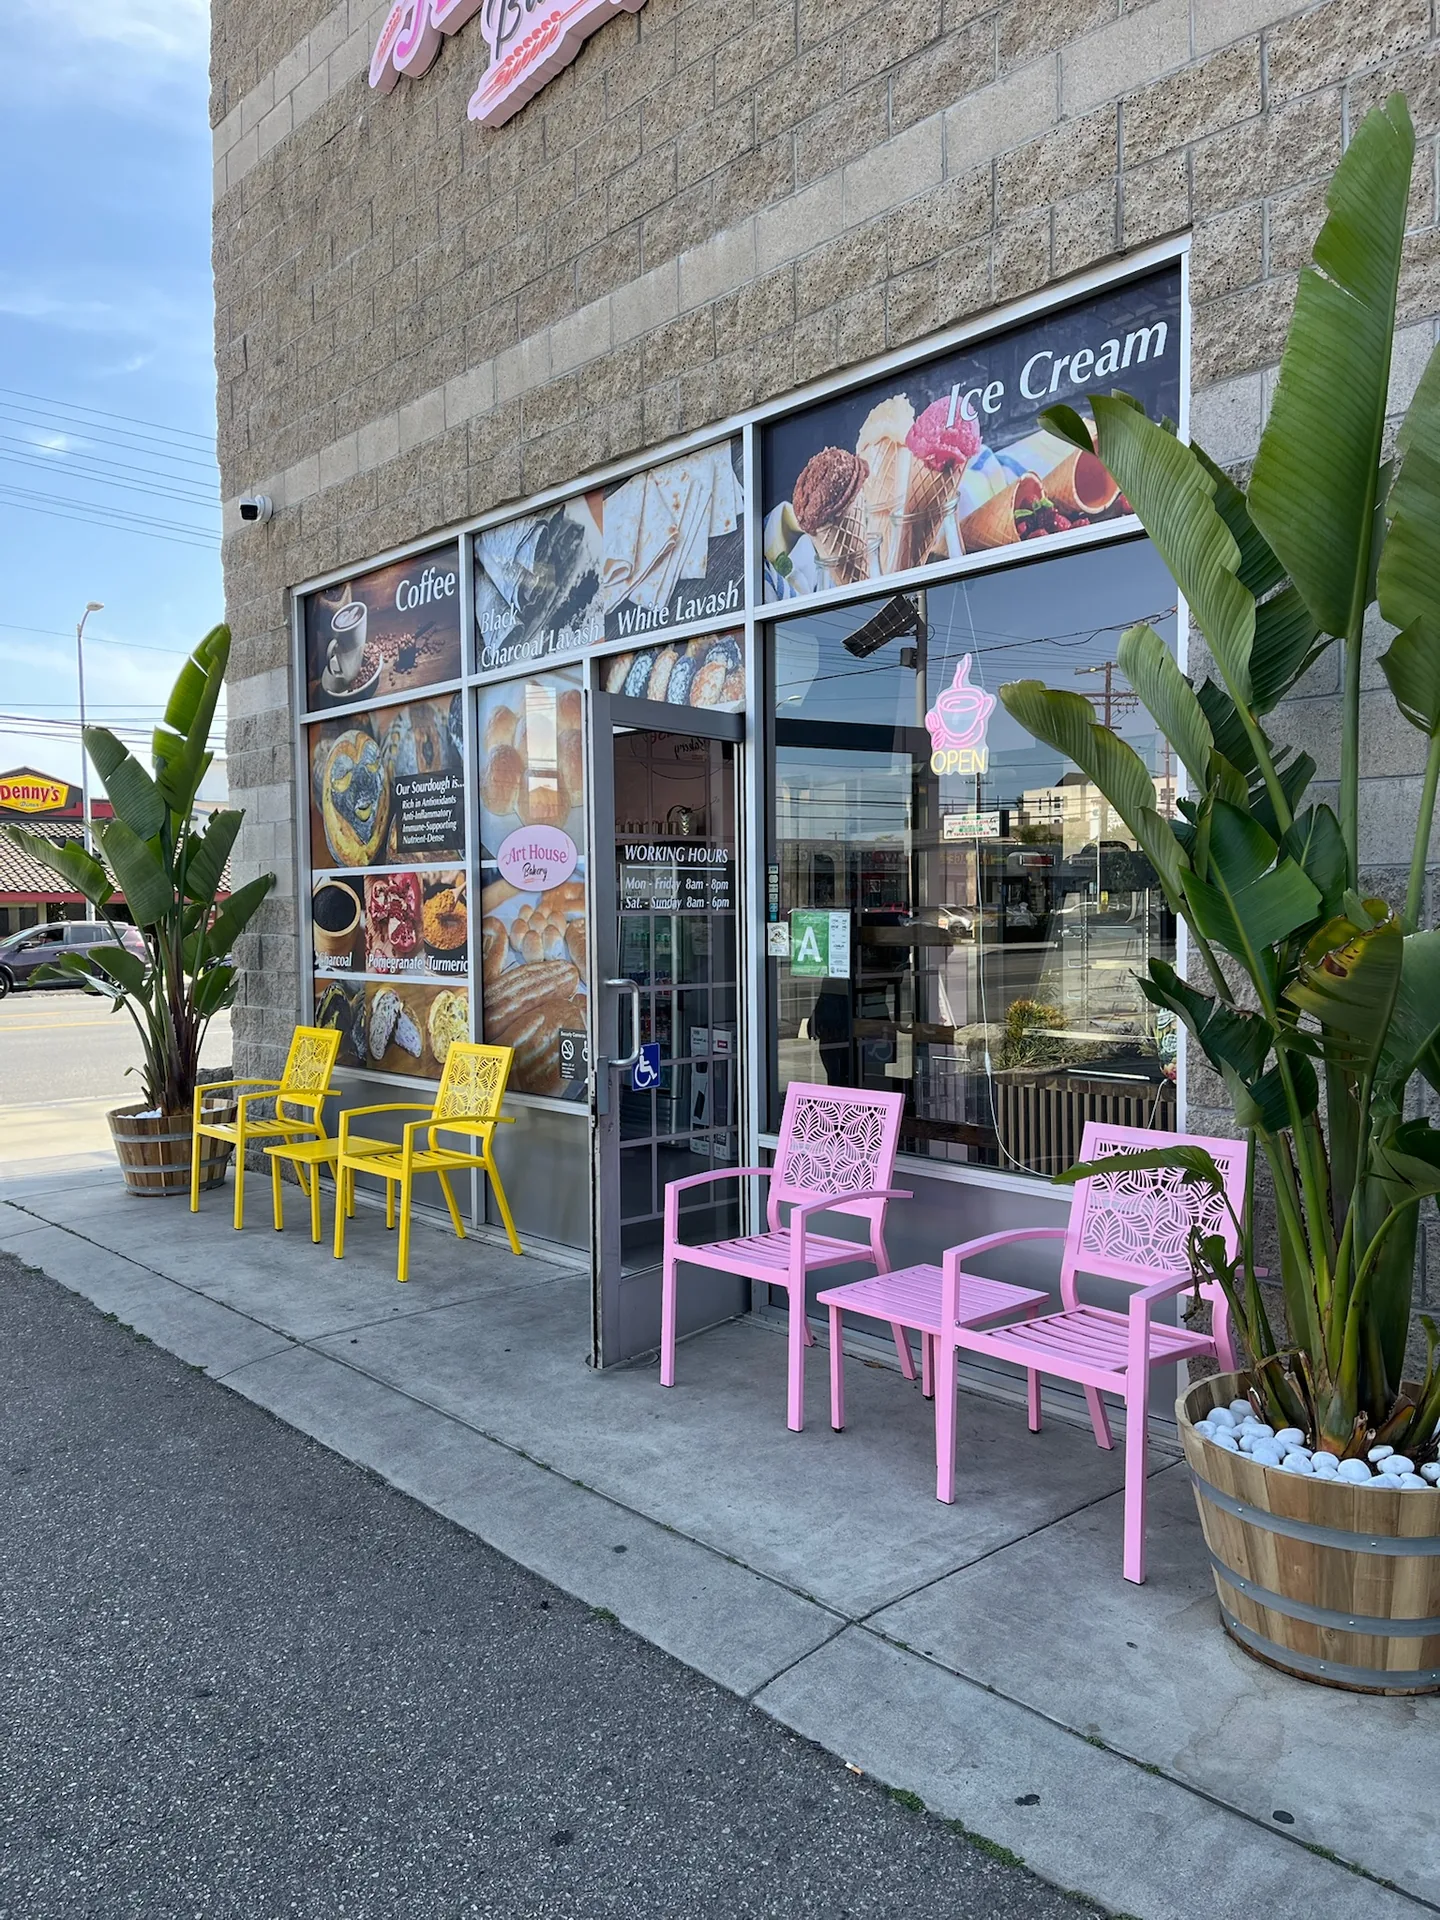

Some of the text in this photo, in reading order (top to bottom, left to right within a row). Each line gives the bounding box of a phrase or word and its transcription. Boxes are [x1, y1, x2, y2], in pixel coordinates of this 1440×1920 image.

[946, 321, 1168, 428] Ice Cream
[395, 566, 456, 612] Coffee
[617, 579, 739, 636] White Lavash
[480, 603, 518, 634] Black
[481, 623, 599, 668] Charcoal Lavash
[931, 749, 986, 774] OPEN
[0, 785, 60, 802] Denny's
[395, 783, 410, 796] Our
[411, 775, 450, 794] Sourdough
[402, 795, 457, 809] Rich in Antioxidants
[402, 809, 452, 821] Anti-Inflammatory
[402, 821, 457, 833] Immune-Supporting
[402, 833, 445, 844] Nutrient-Dense
[502, 843, 569, 865] Art House
[625, 845, 729, 863] WORKING HOURS
[522, 862, 548, 882] Bakery
[625, 877, 646, 890] Mon
[654, 877, 681, 893] Friday
[685, 878, 704, 890] 8am
[710, 879, 729, 893] 8pm
[625, 896, 643, 909] Sat.
[650, 896, 682, 911] Sunday
[686, 896, 705, 908] 8am
[711, 897, 730, 911] 6pm
[797, 926, 822, 962] A
[319, 952, 468, 973] Charcoal Pomegranate Turmeric
